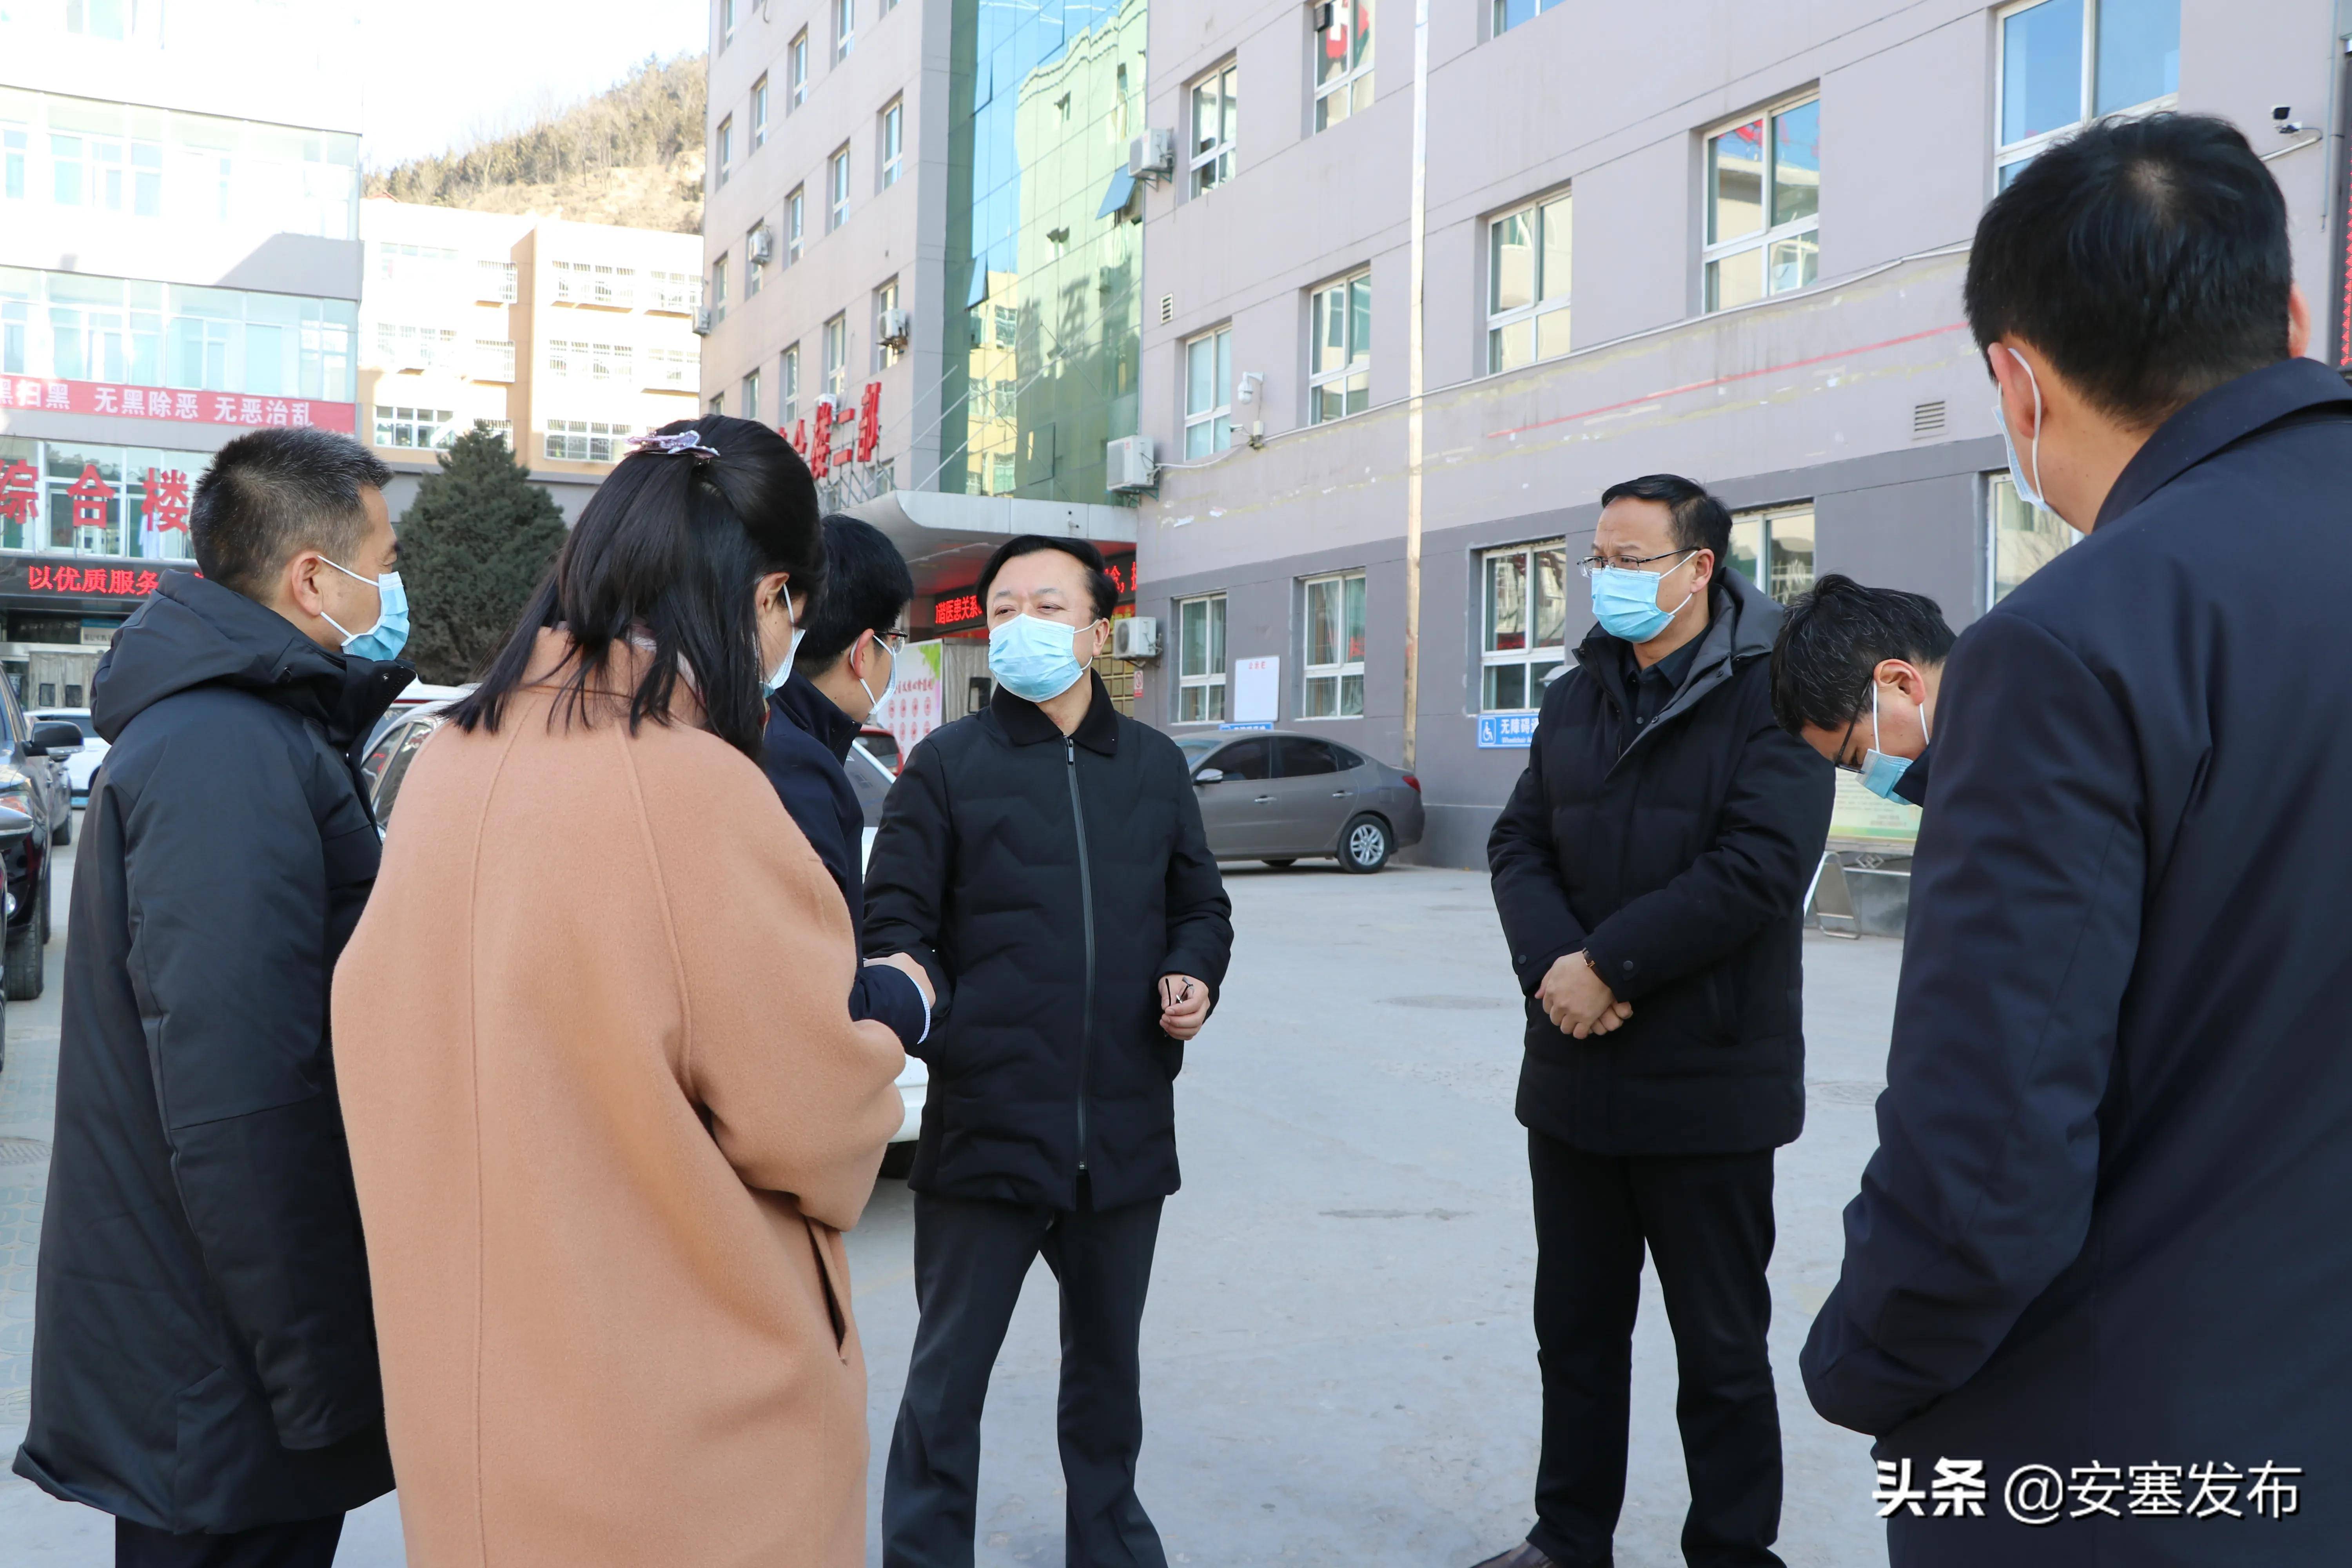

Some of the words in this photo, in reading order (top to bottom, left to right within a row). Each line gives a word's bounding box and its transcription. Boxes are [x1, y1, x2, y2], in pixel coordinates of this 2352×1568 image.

[94, 387, 199, 419] 无黑除恶
[214, 396, 314, 426] 无恶治乱
[0, 459, 189, 534] 综合楼
[28, 565, 159, 596] 以优质服务
